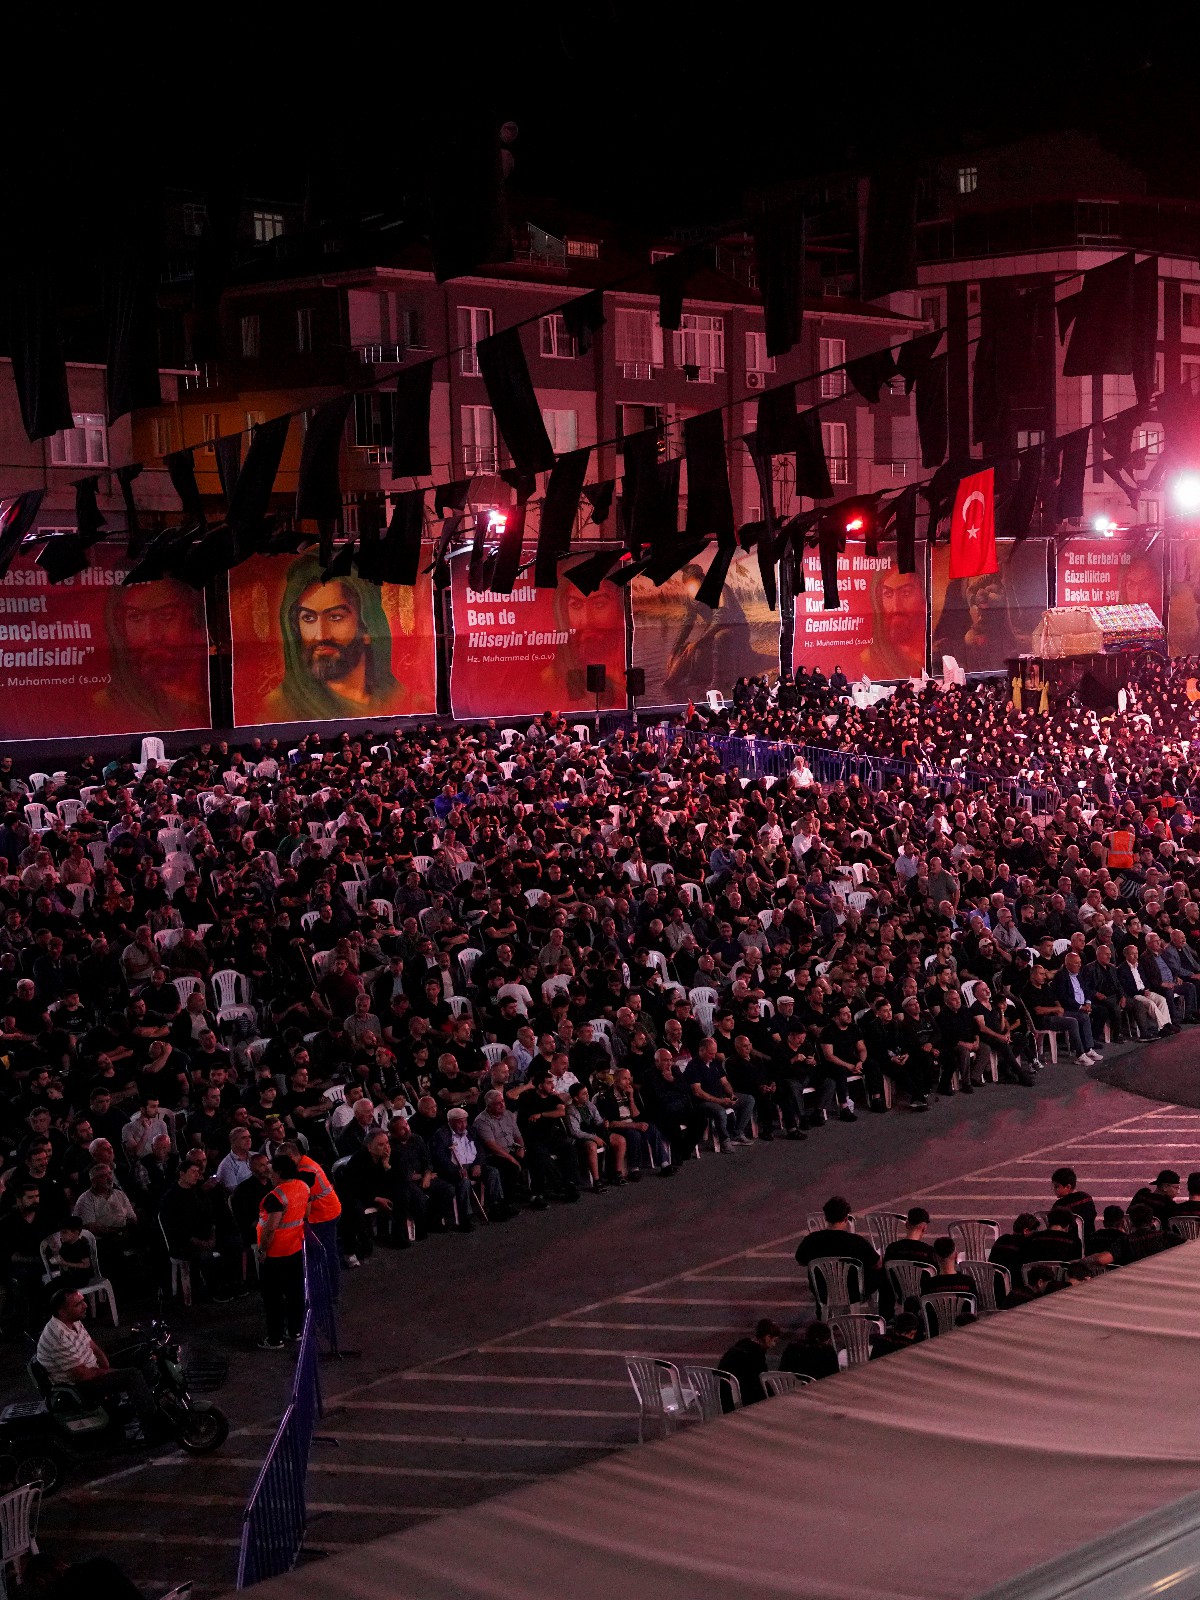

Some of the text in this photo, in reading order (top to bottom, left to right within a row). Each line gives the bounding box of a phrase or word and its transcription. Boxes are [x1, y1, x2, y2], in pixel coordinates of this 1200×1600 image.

[0, 569, 48, 586] asan
[1064, 569, 1111, 584] Güzellikten
[853, 578, 867, 591] ve
[1064, 588, 1120, 603] Başka bir şey
[467, 608, 516, 627] Ben de
[816, 638, 854, 647] Muhammed
[466, 652, 556, 663] Hz. Muhammed (s.a.v)
[7, 674, 75, 687] Muhammed
[78, 673, 112, 684] (s.a.v)
